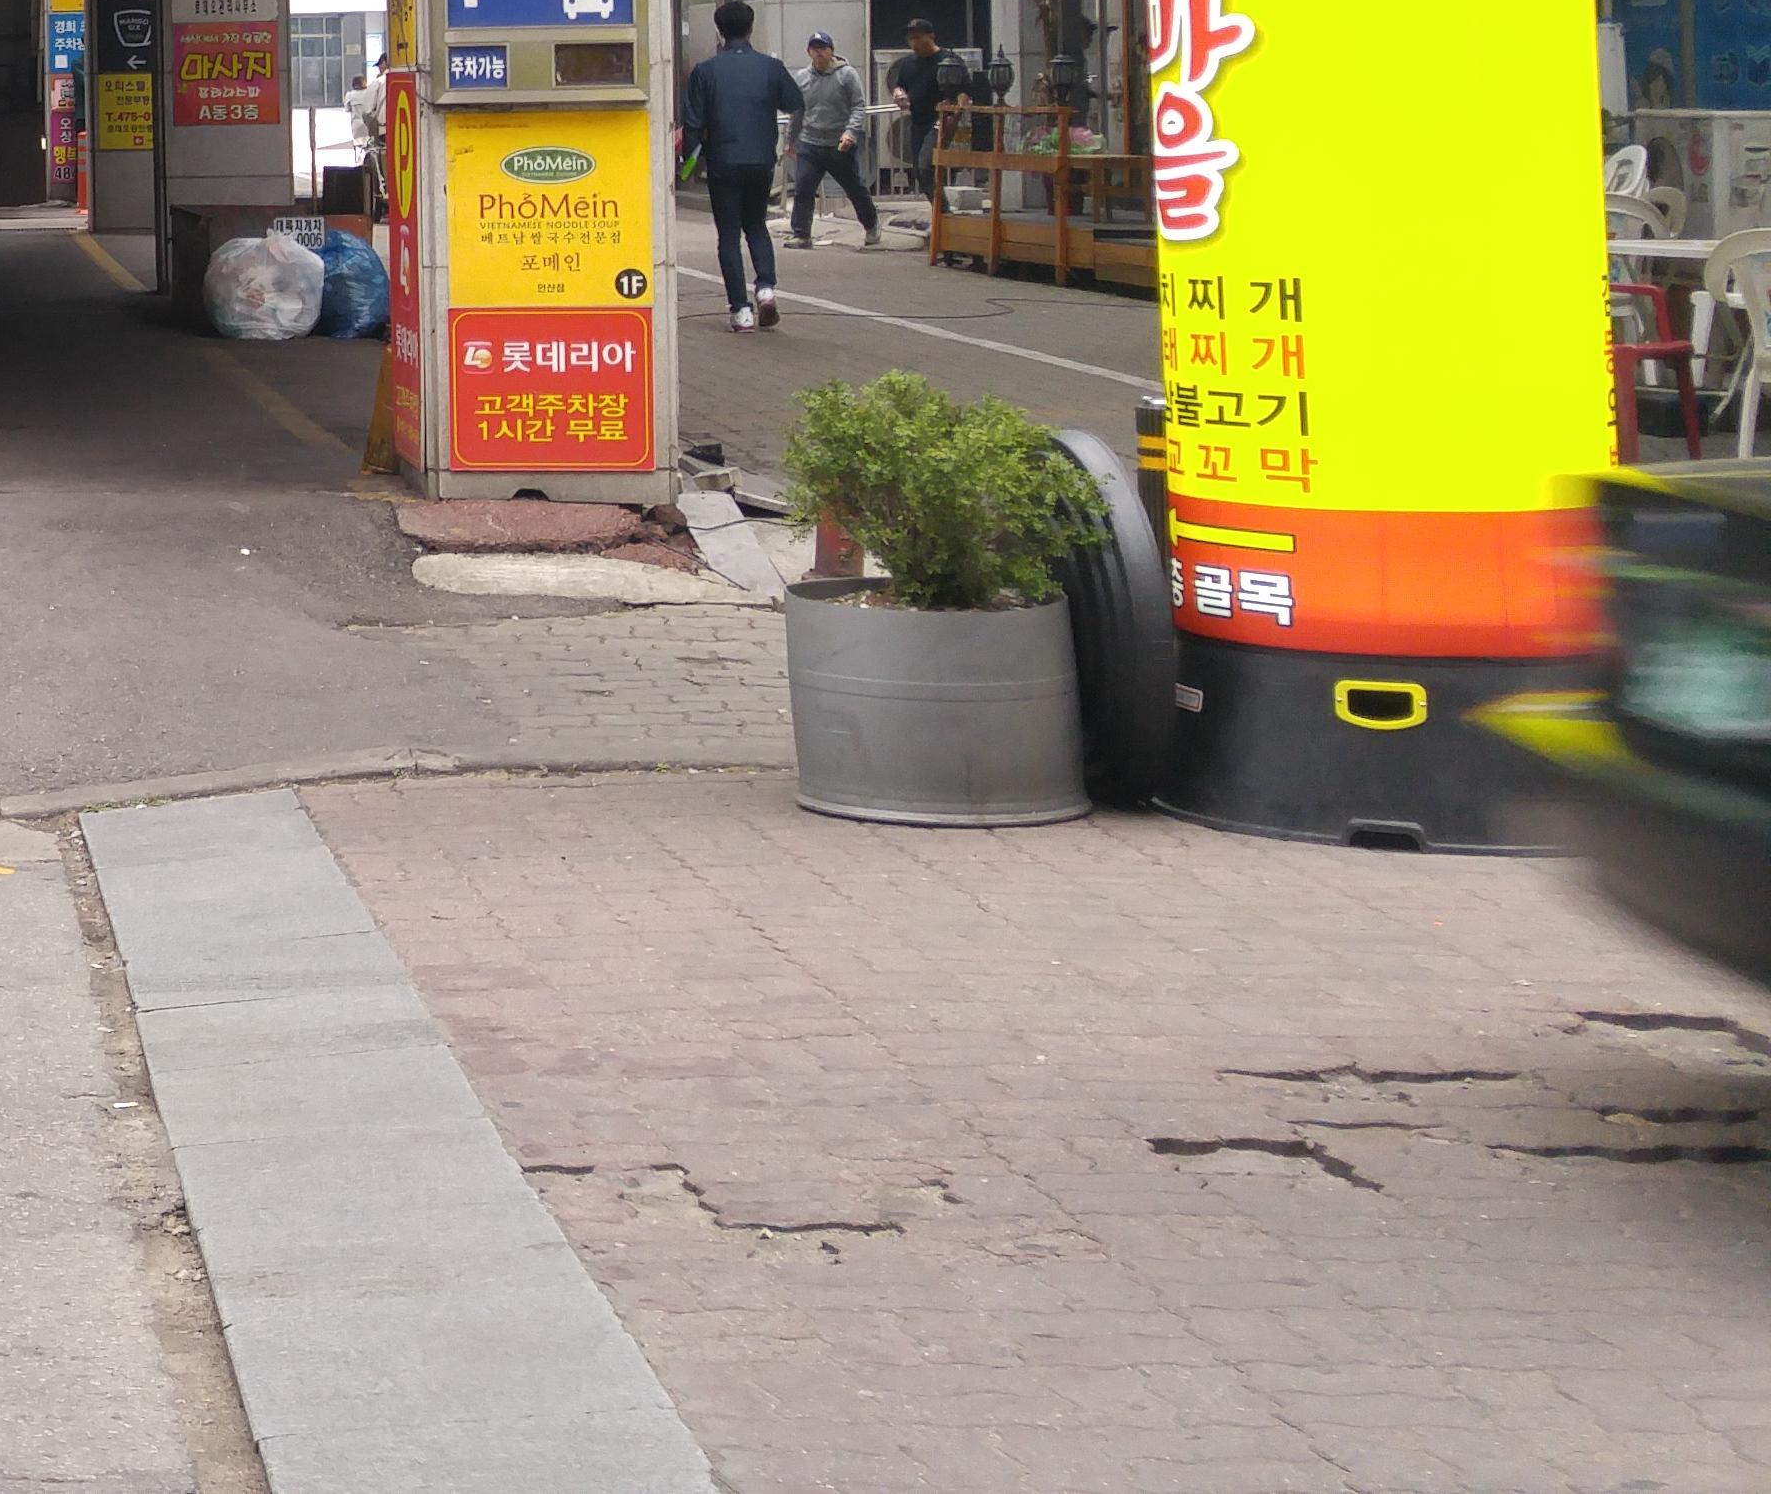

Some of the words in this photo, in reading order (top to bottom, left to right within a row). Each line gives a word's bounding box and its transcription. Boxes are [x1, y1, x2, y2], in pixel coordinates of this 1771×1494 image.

[55, 20, 76, 34] 경희
[180, 51, 273, 81] 마사지
[450, 56, 506, 80] 주차가능
[105, 111, 153, 122] T.475-0
[479, 221, 542, 230] VIETNAMESE
[546, 220, 589, 229] NOODLE
[591, 220, 620, 229] SOUP
[521, 252, 581, 272] 포메인
[619, 275, 644, 295] 1F
[501, 340, 636, 373] 롯데리아
[474, 393, 629, 417] 고객주차장
[478, 418, 555, 442] 1시간
[566, 419, 629, 442] 무료
[1194, 565, 1294, 627] 골목
